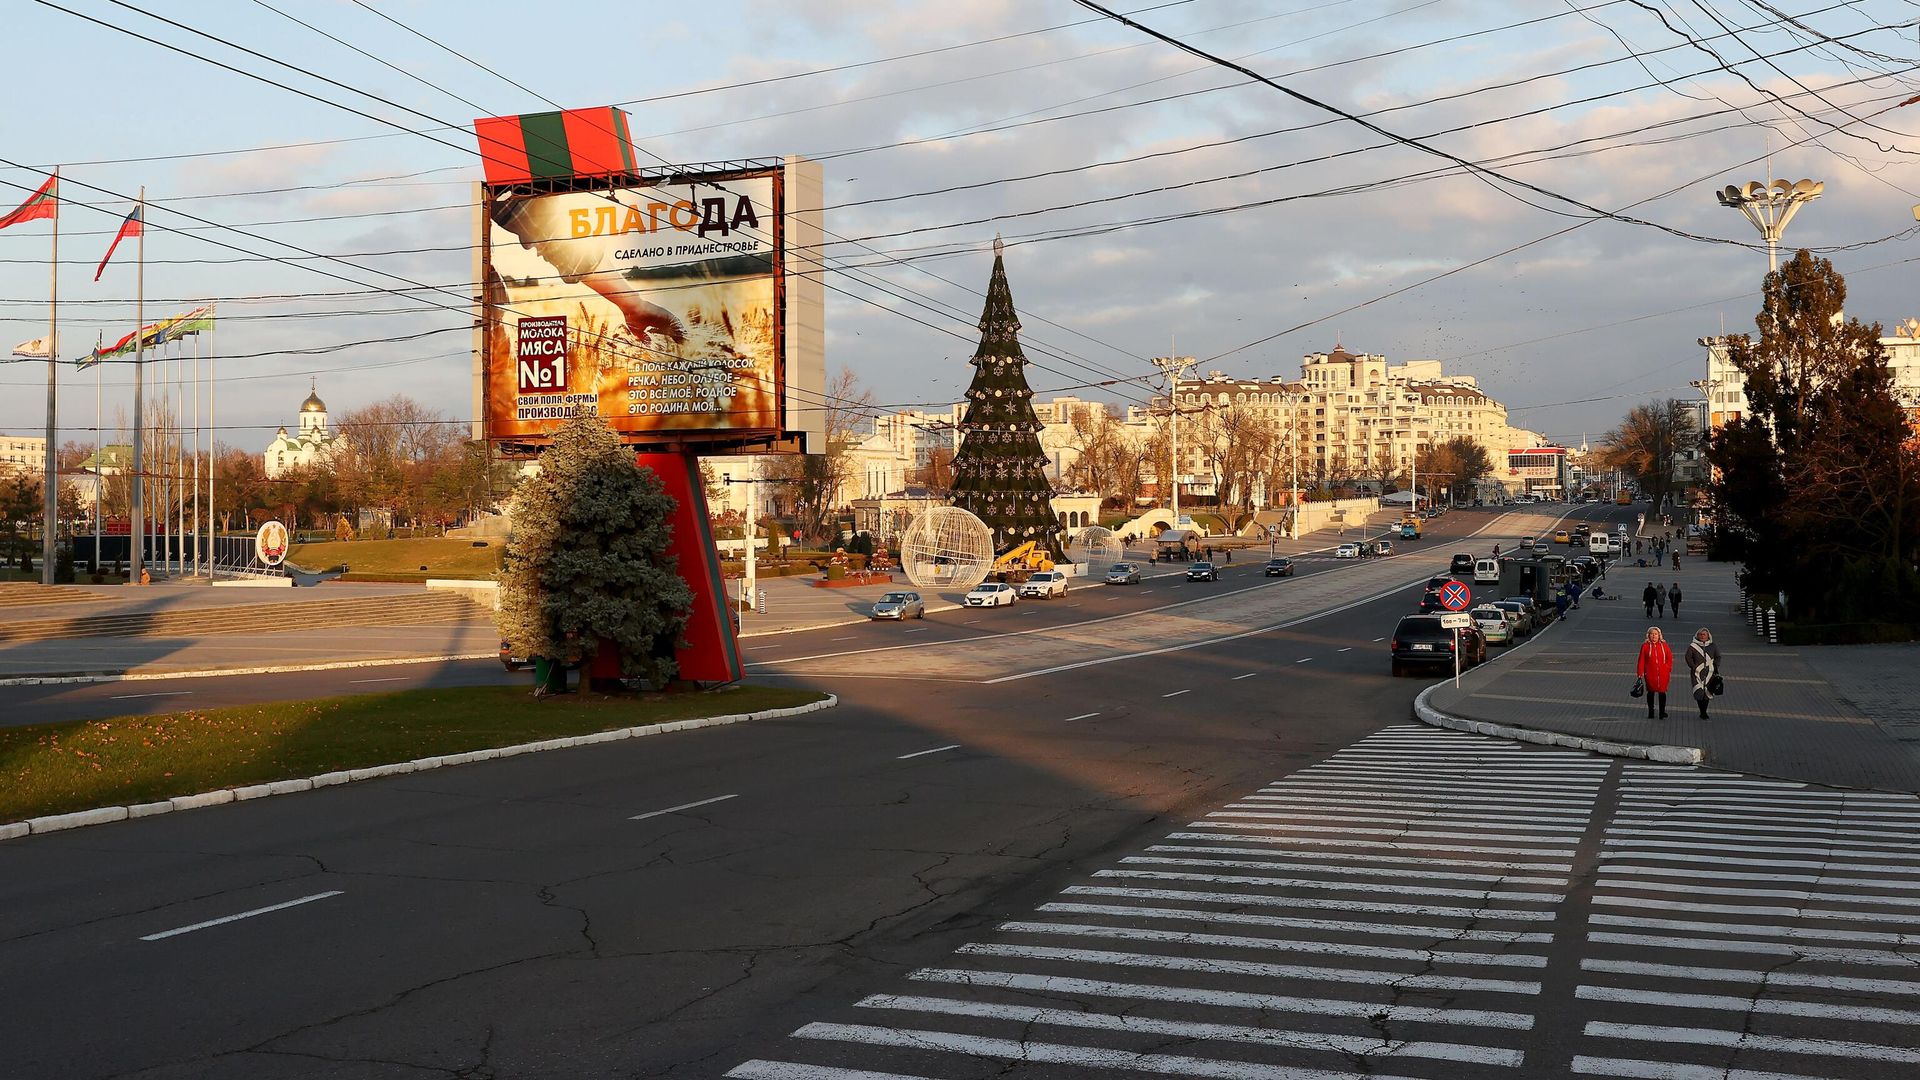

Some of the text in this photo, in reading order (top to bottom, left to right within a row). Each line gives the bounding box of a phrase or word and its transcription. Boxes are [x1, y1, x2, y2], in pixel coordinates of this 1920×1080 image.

[569, 195, 759, 239] БЛАГОДА
[614, 240, 759, 261] СДЕЛАНО В ПРИДНЕСТРОВЬЕ
[520, 327, 565, 339] МОЛОКА
[520, 340, 565, 356] МЯСА
[642, 362, 666, 372] ПОЛЕ
[628, 376, 659, 387] РЕЧКА,
[661, 374, 686, 385] НЕБО
[688, 372, 733, 384] ГОЛУБОЕ
[518, 395, 539, 406] СВОИ
[565, 394, 598, 404] ФЕРМЫ
[629, 389, 648, 400] ЭТО
[669, 386, 694, 399] МОЁ,
[695, 386, 737, 398] РОДНОЕ
[518, 405, 598, 419] ПРОИЗВОДСО
[629, 404, 648, 414] ЭТО
[649, 403, 690, 414] РОДИНА
